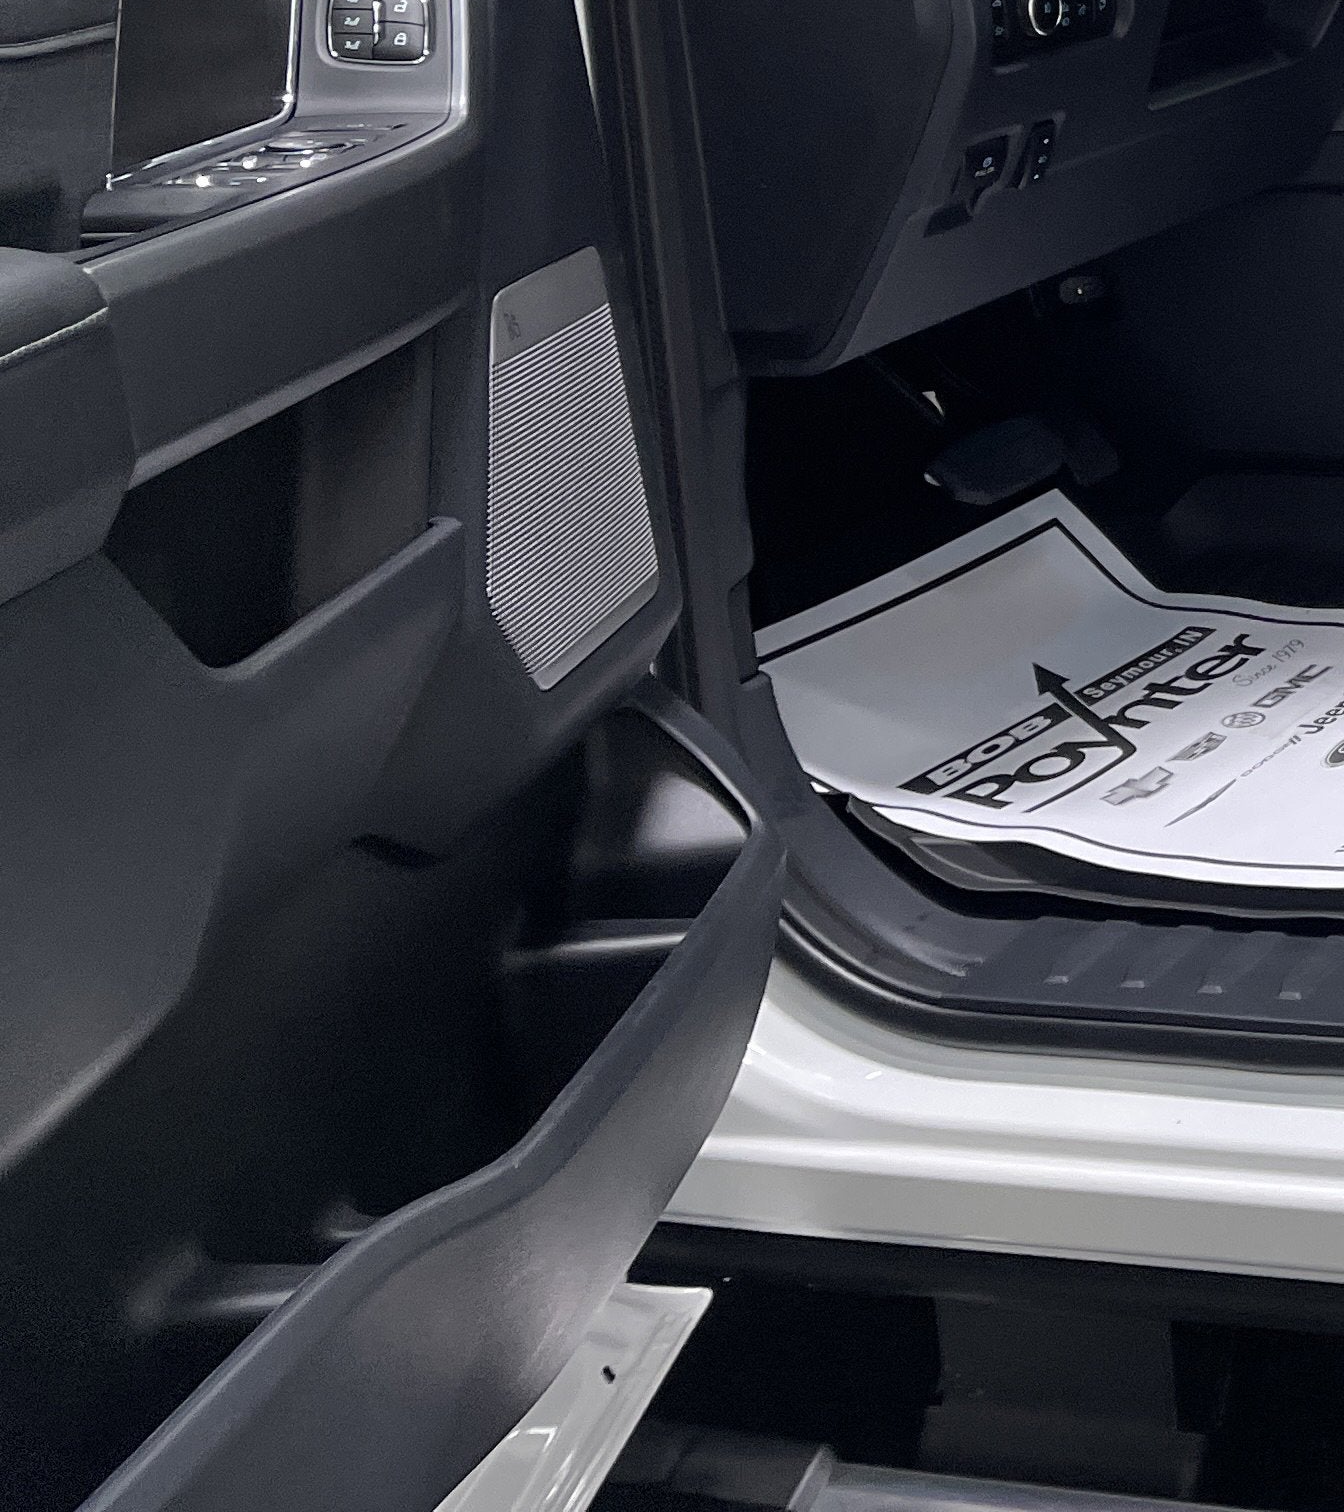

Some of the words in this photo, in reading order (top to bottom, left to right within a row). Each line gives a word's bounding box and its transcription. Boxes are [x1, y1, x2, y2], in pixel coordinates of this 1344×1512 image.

[1172, 629, 1203, 646] IN
[1271, 638, 1305, 663] 1979
[1252, 664, 1334, 708] GMC
[925, 715, 1052, 786] BOB
